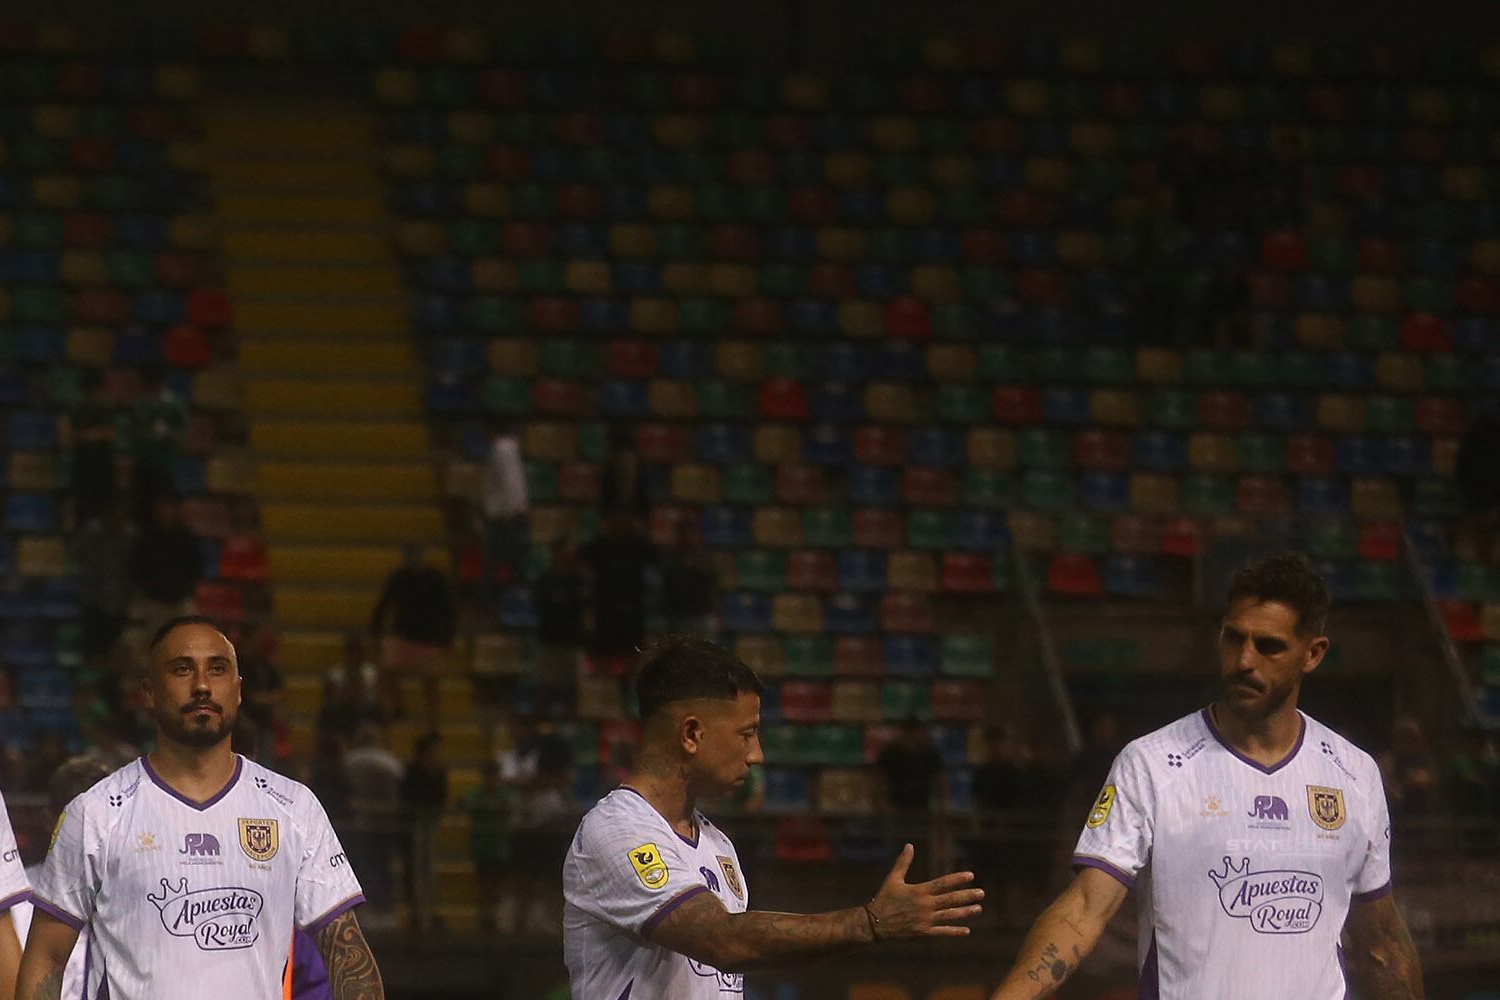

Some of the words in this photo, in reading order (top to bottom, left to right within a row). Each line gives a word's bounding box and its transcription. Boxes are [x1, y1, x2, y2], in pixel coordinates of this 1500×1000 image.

[1230, 875, 1319, 910] Apuestas
[172, 892, 257, 930] Apuestas
[1257, 901, 1313, 931] Royal
[201, 917, 254, 946] Royal
